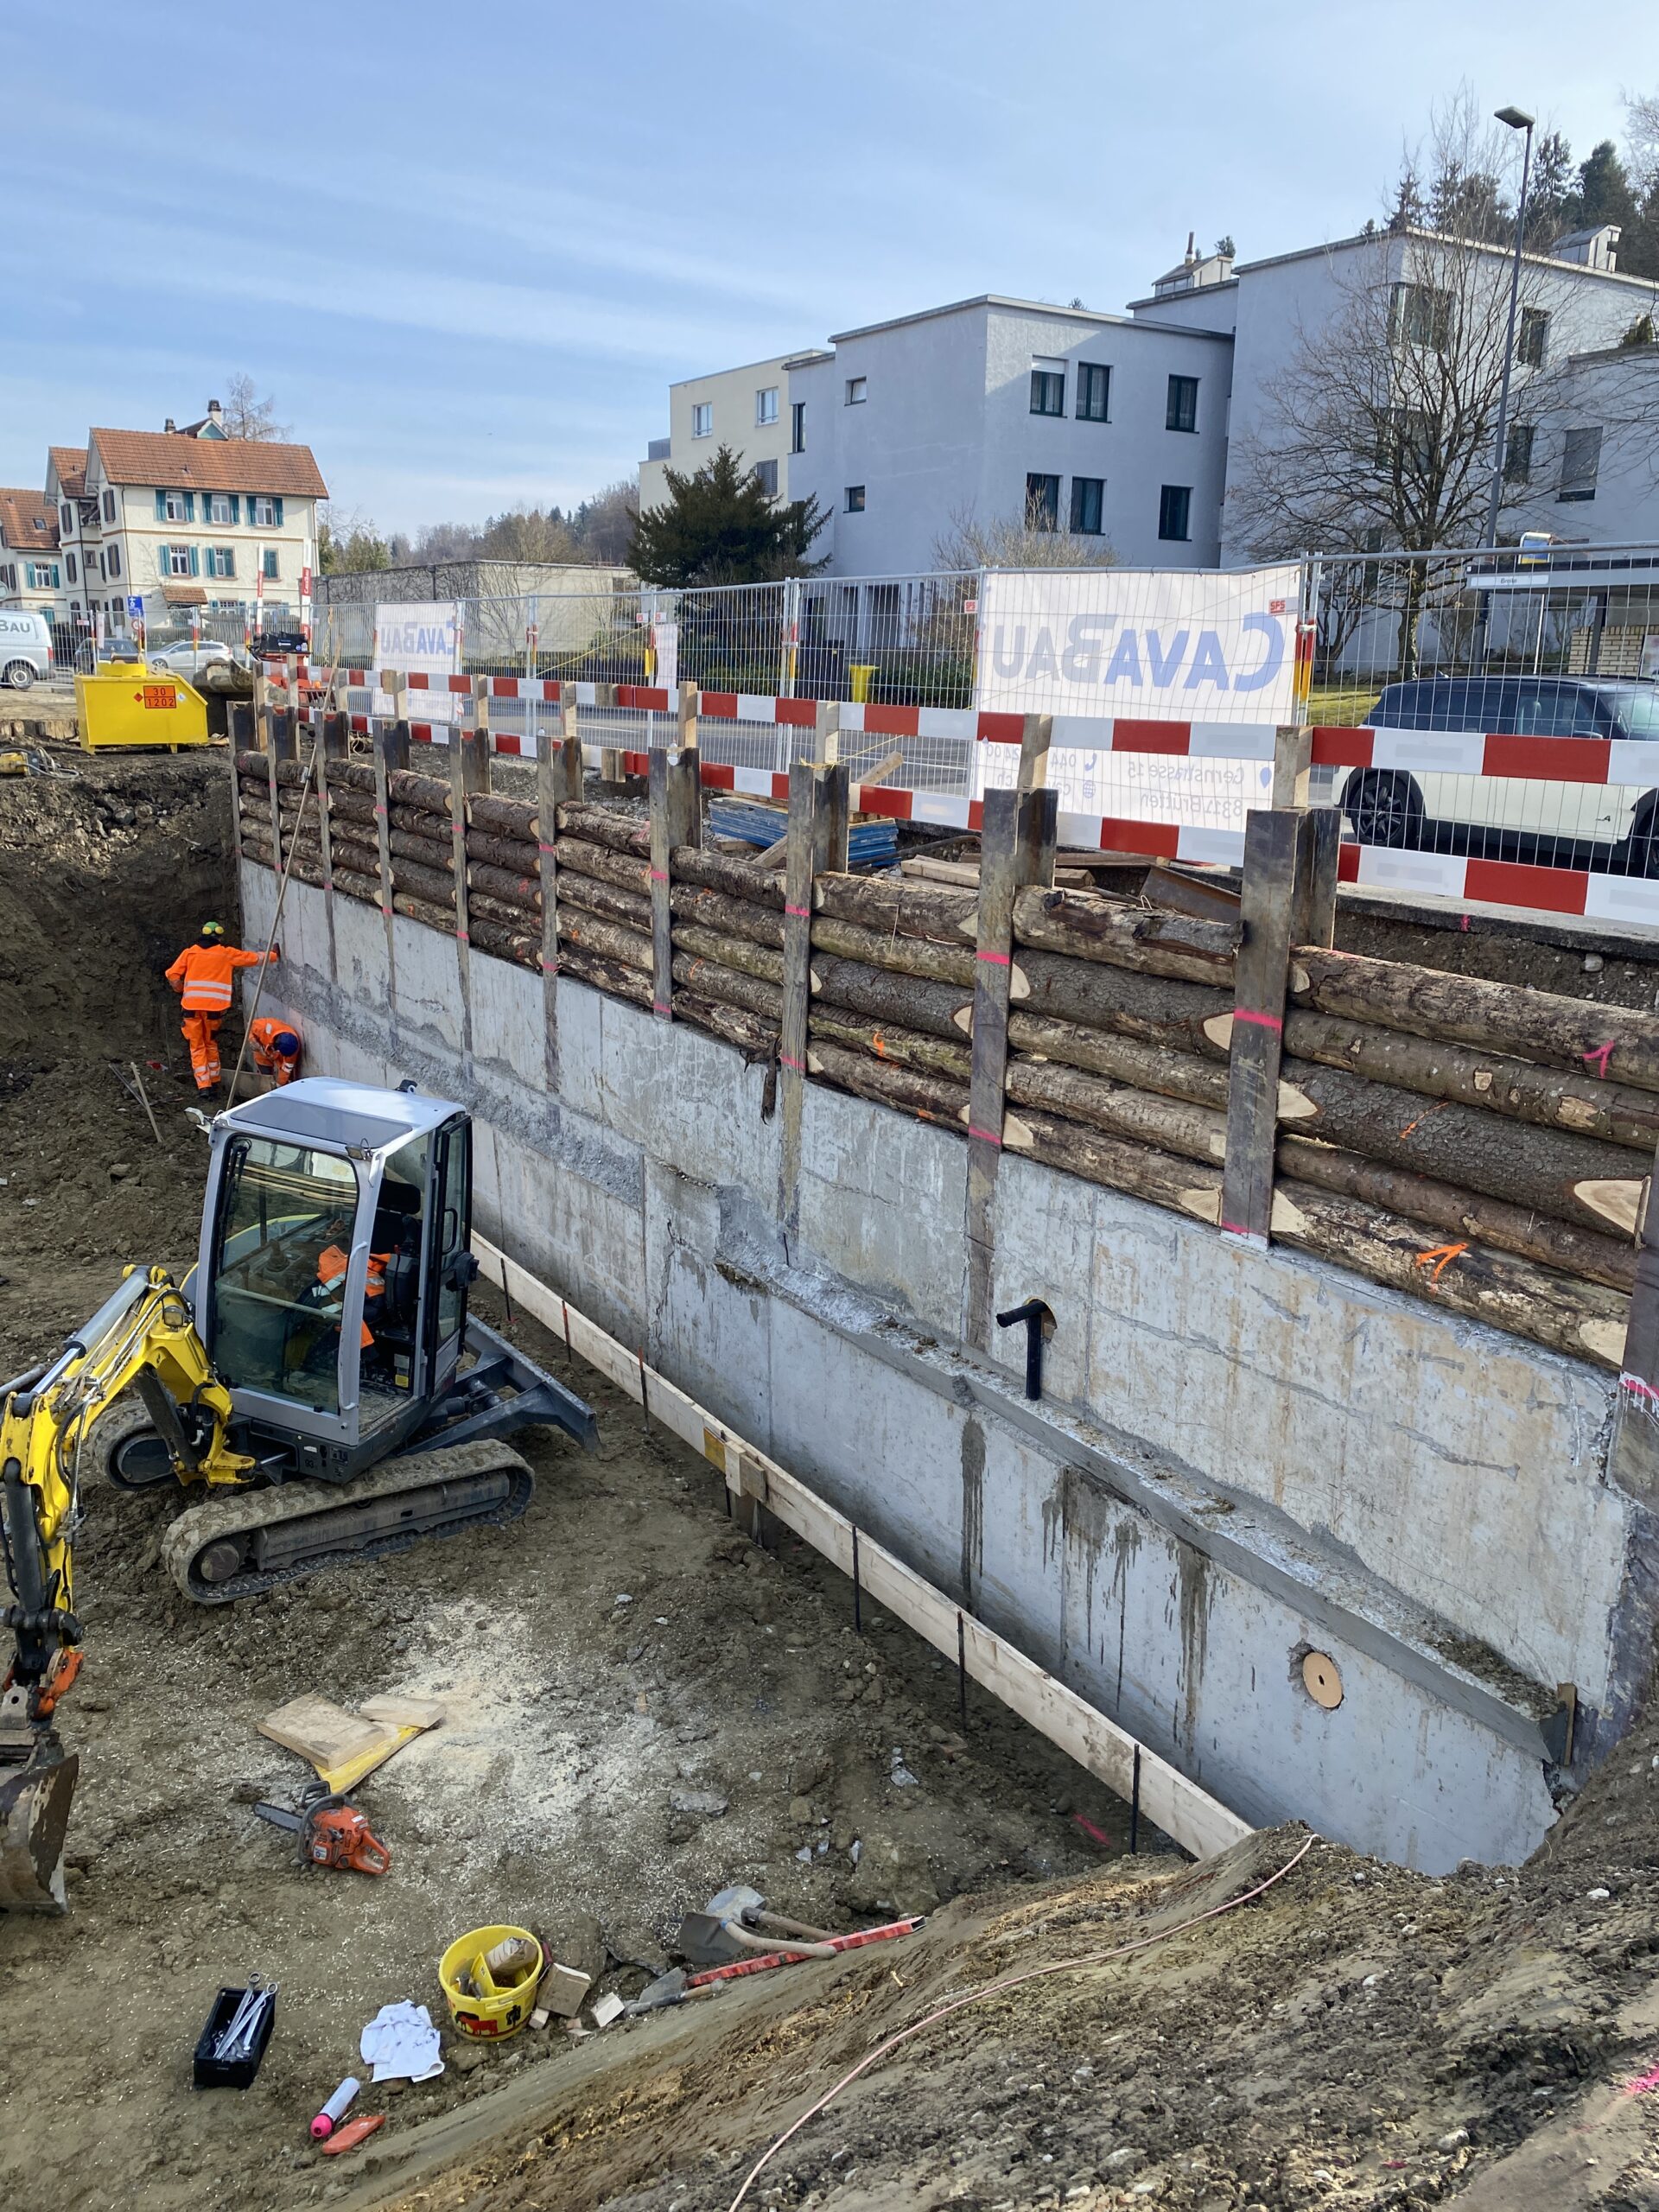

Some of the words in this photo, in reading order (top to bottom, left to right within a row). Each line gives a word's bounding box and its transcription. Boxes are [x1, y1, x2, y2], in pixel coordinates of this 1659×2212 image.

[1270, 600, 1286, 611] SFS
[153, 687, 166, 696] 30
[148, 698, 175, 707] 1202
